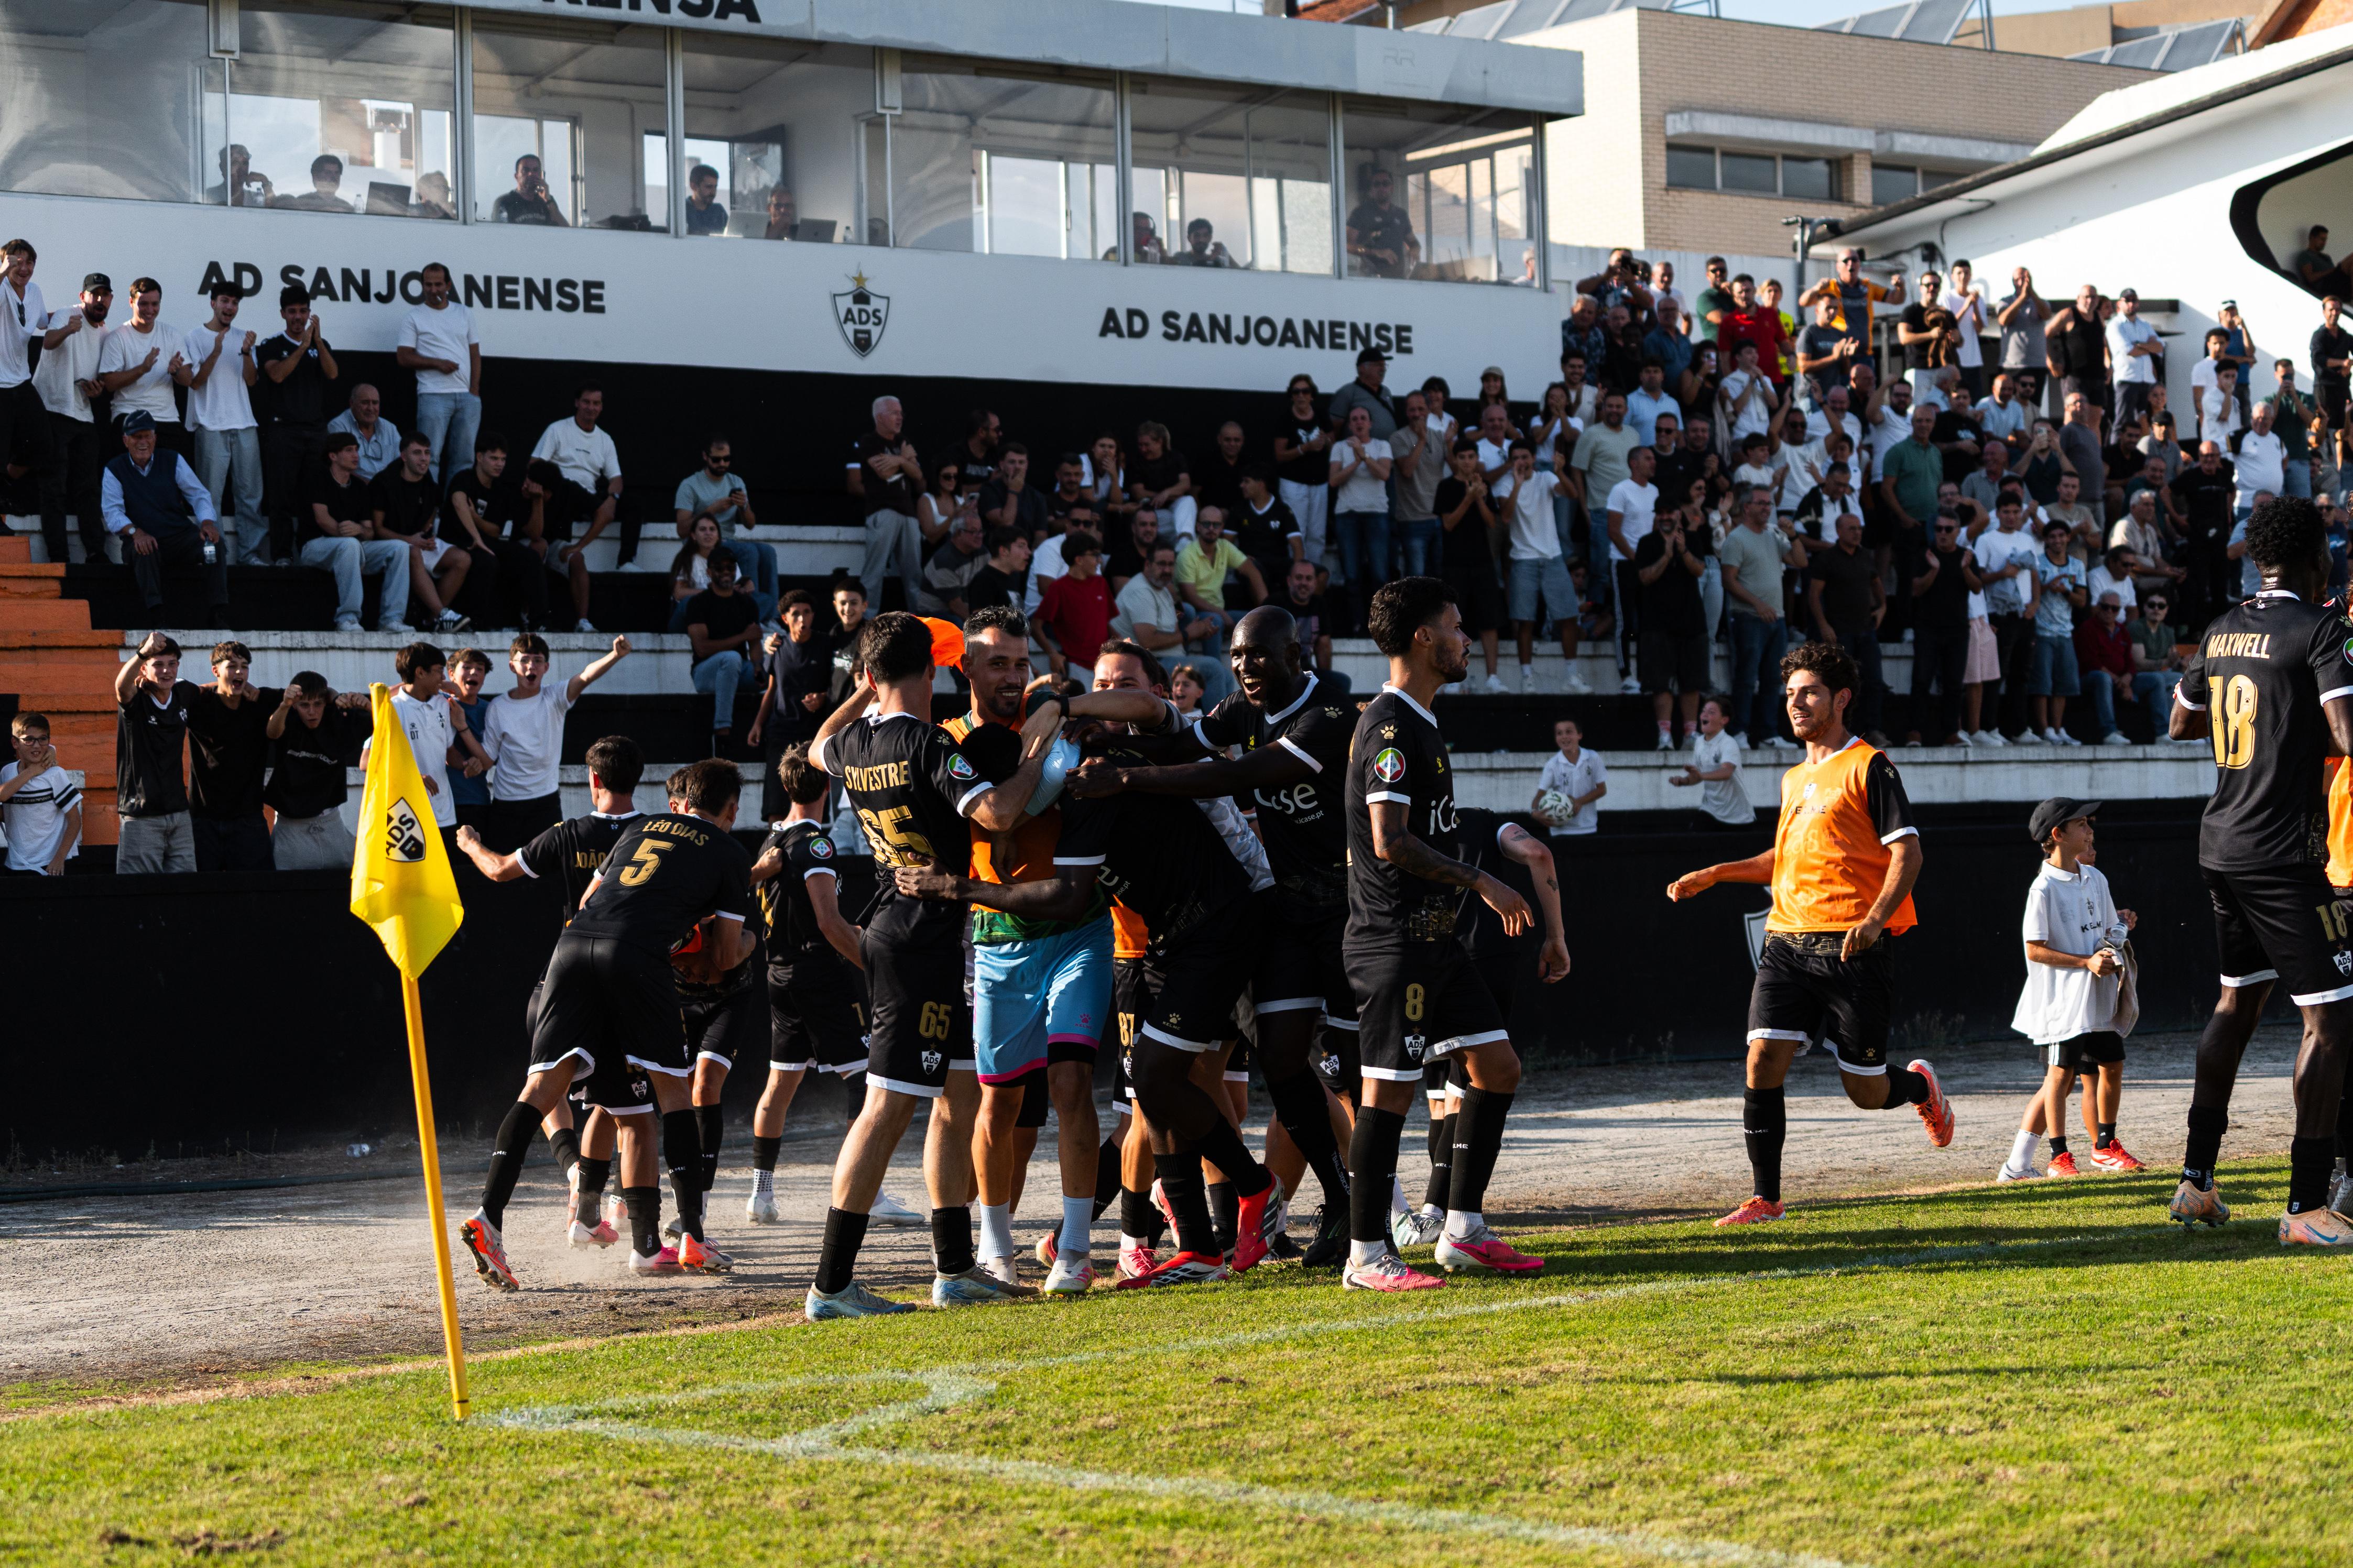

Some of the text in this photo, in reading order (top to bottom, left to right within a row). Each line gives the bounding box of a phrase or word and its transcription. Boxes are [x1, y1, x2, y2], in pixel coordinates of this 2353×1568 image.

[198, 261, 263, 297] AD
[843, 307, 883, 326] ADS
[1099, 307, 1413, 354] AD SANJOANENSE
[2207, 633, 2271, 659] MAXWELL
[2208, 674, 2259, 770] 18
[844, 760, 910, 792] SYLVESTRE
[642, 819, 709, 847] LÉO DIAS
[619, 838, 676, 886] 5
[2315, 901, 2348, 942] 18
[2338, 956, 2351, 967] ADS
[1406, 983, 1425, 1022] 8
[919, 1001, 953, 1041] 65
[1162, 1021, 1181, 1031] KELME
[923, 1055, 939, 1065] ADS
[1324, 1059, 1338, 1071] ADS
[634, 1084, 647, 1092] ADS
